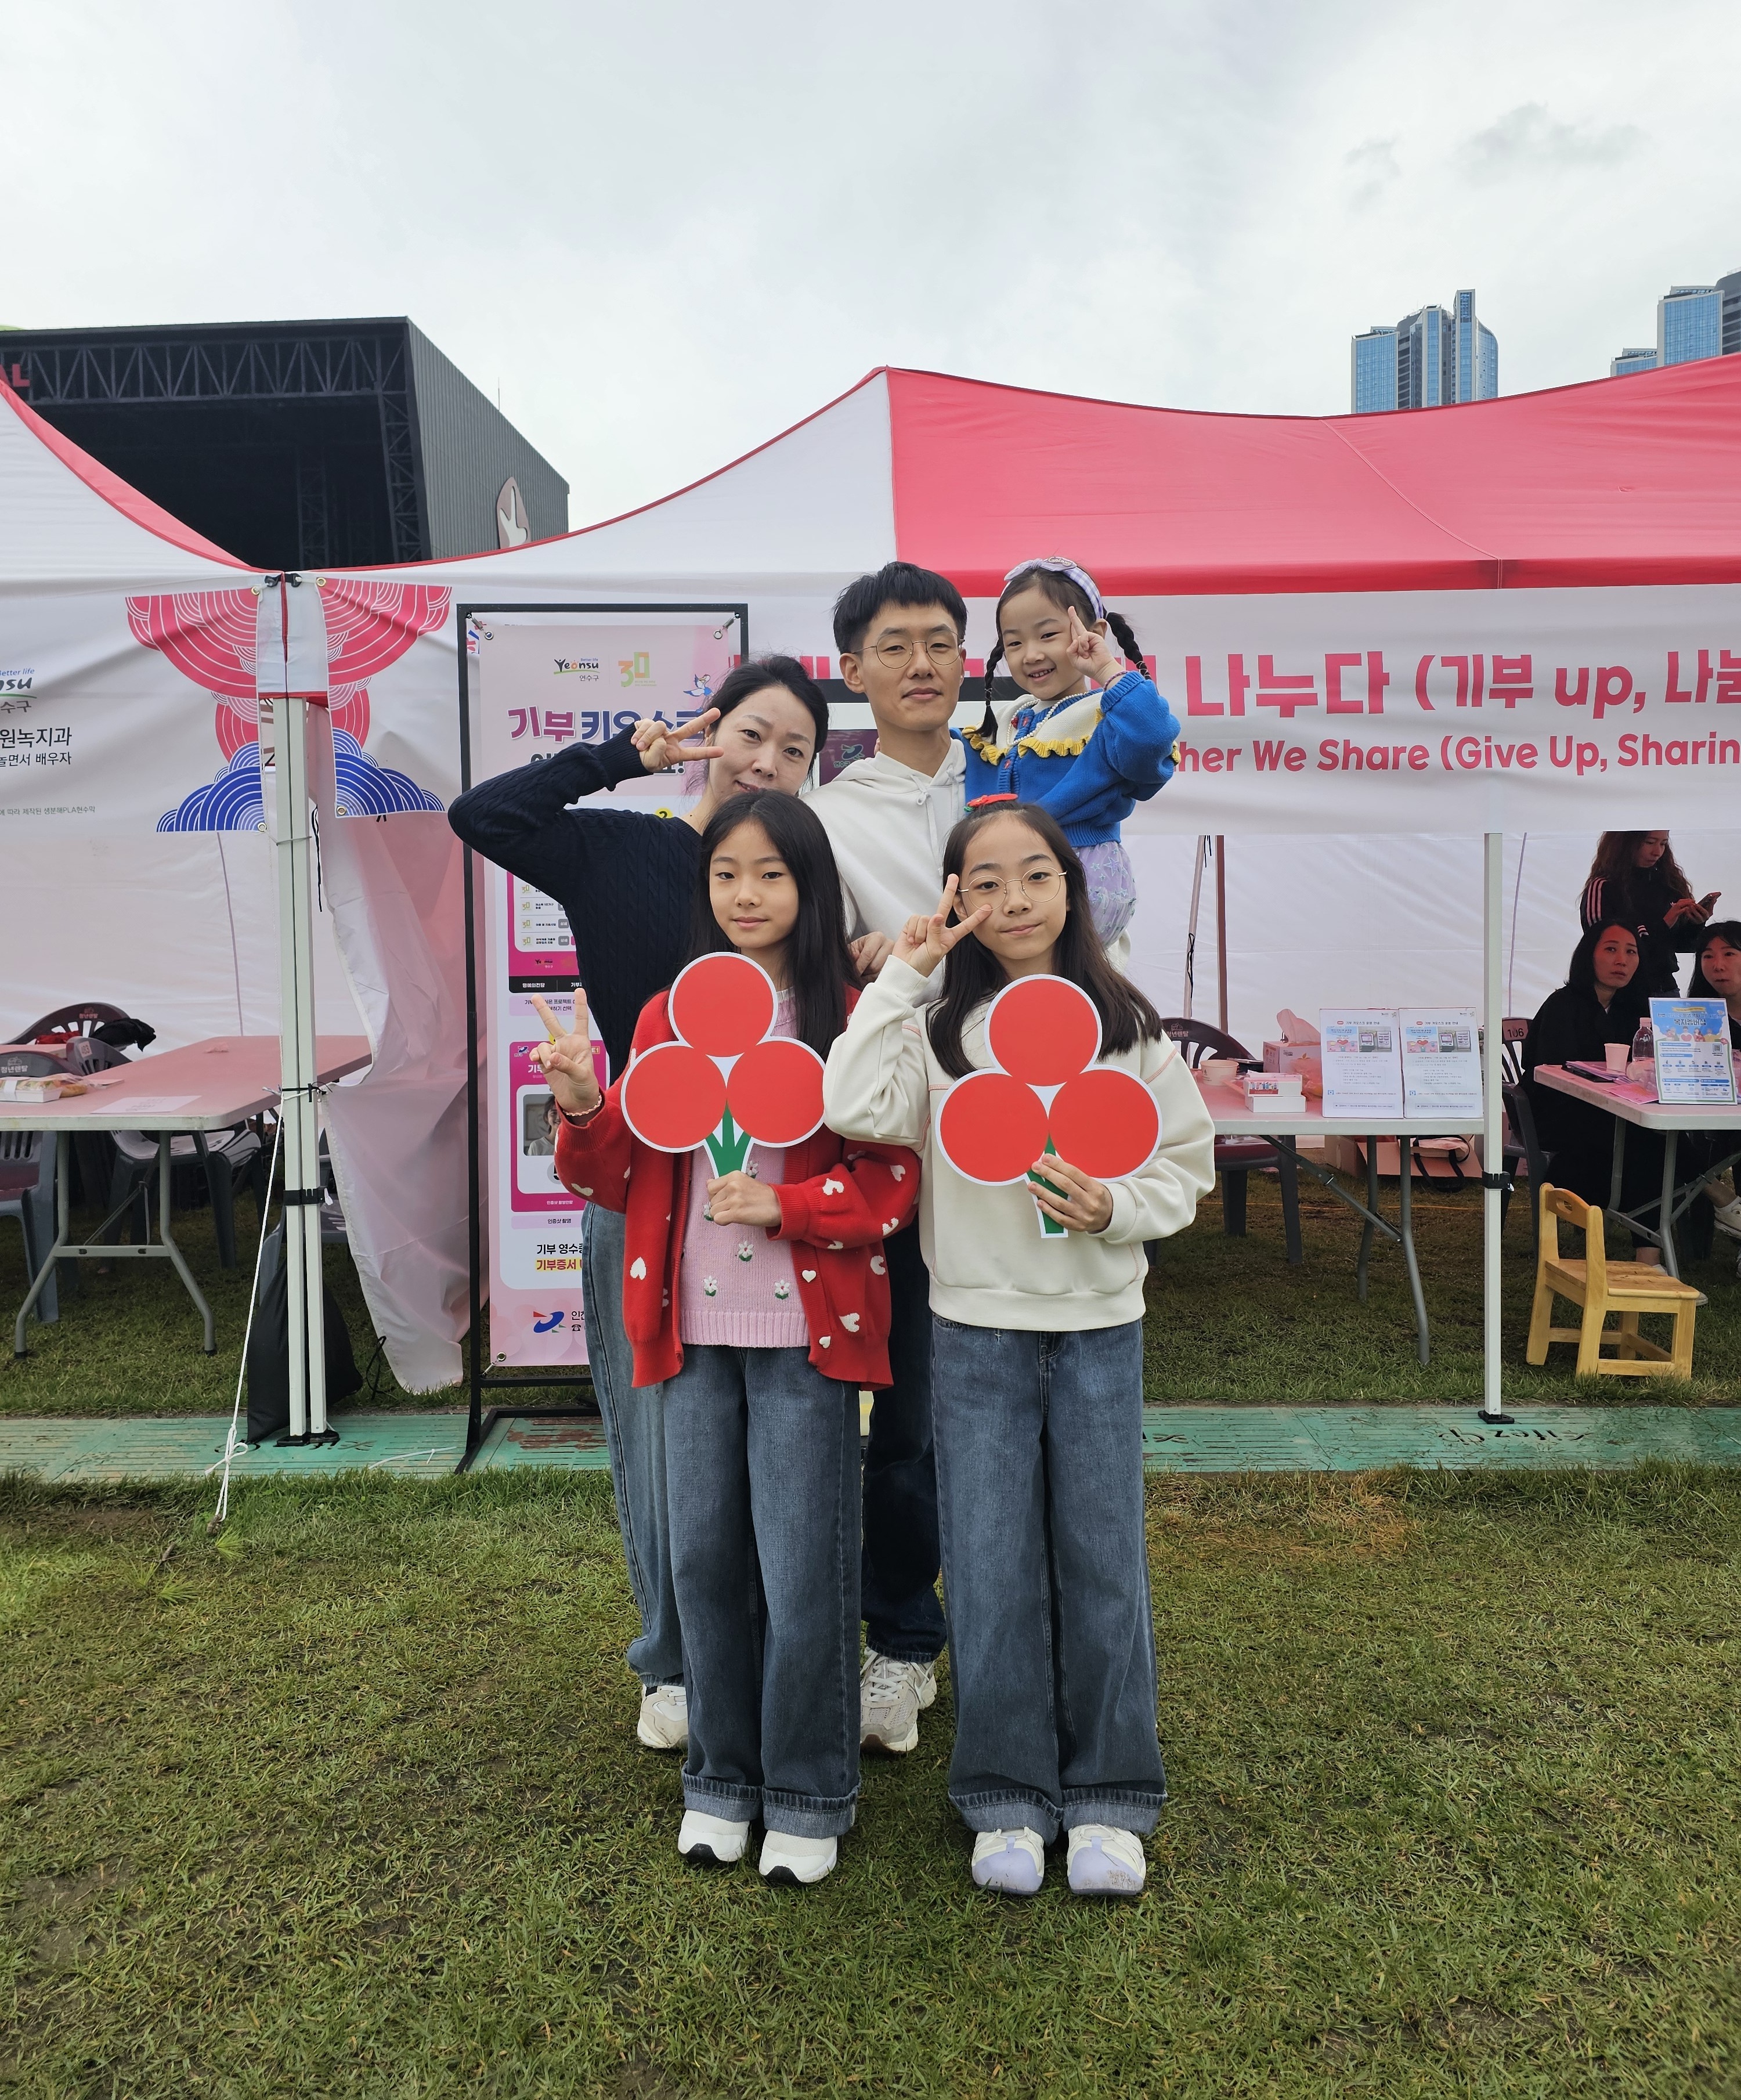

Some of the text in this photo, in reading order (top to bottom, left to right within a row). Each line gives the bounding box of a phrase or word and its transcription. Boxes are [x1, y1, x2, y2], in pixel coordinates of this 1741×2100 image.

[554, 658, 599, 672] Yeonsu
[1186, 651, 1389, 717] 나누다
[1415, 654, 1534, 710] (기부
[1555, 666, 1646, 719] up,
[508, 706, 575, 742] 기부
[35, 752, 72, 765] 배우자
[1253, 740, 1307, 772] We
[1317, 739, 1430, 771] Share
[1440, 735, 1538, 771] (Give
[1550, 735, 1608, 776] Up,
[1617, 731, 1740, 767] Sharin
[1507, 1028, 1524, 1038] 106
[537, 1244, 556, 1254] 기부
[537, 1259, 576, 1271] 기부증서
